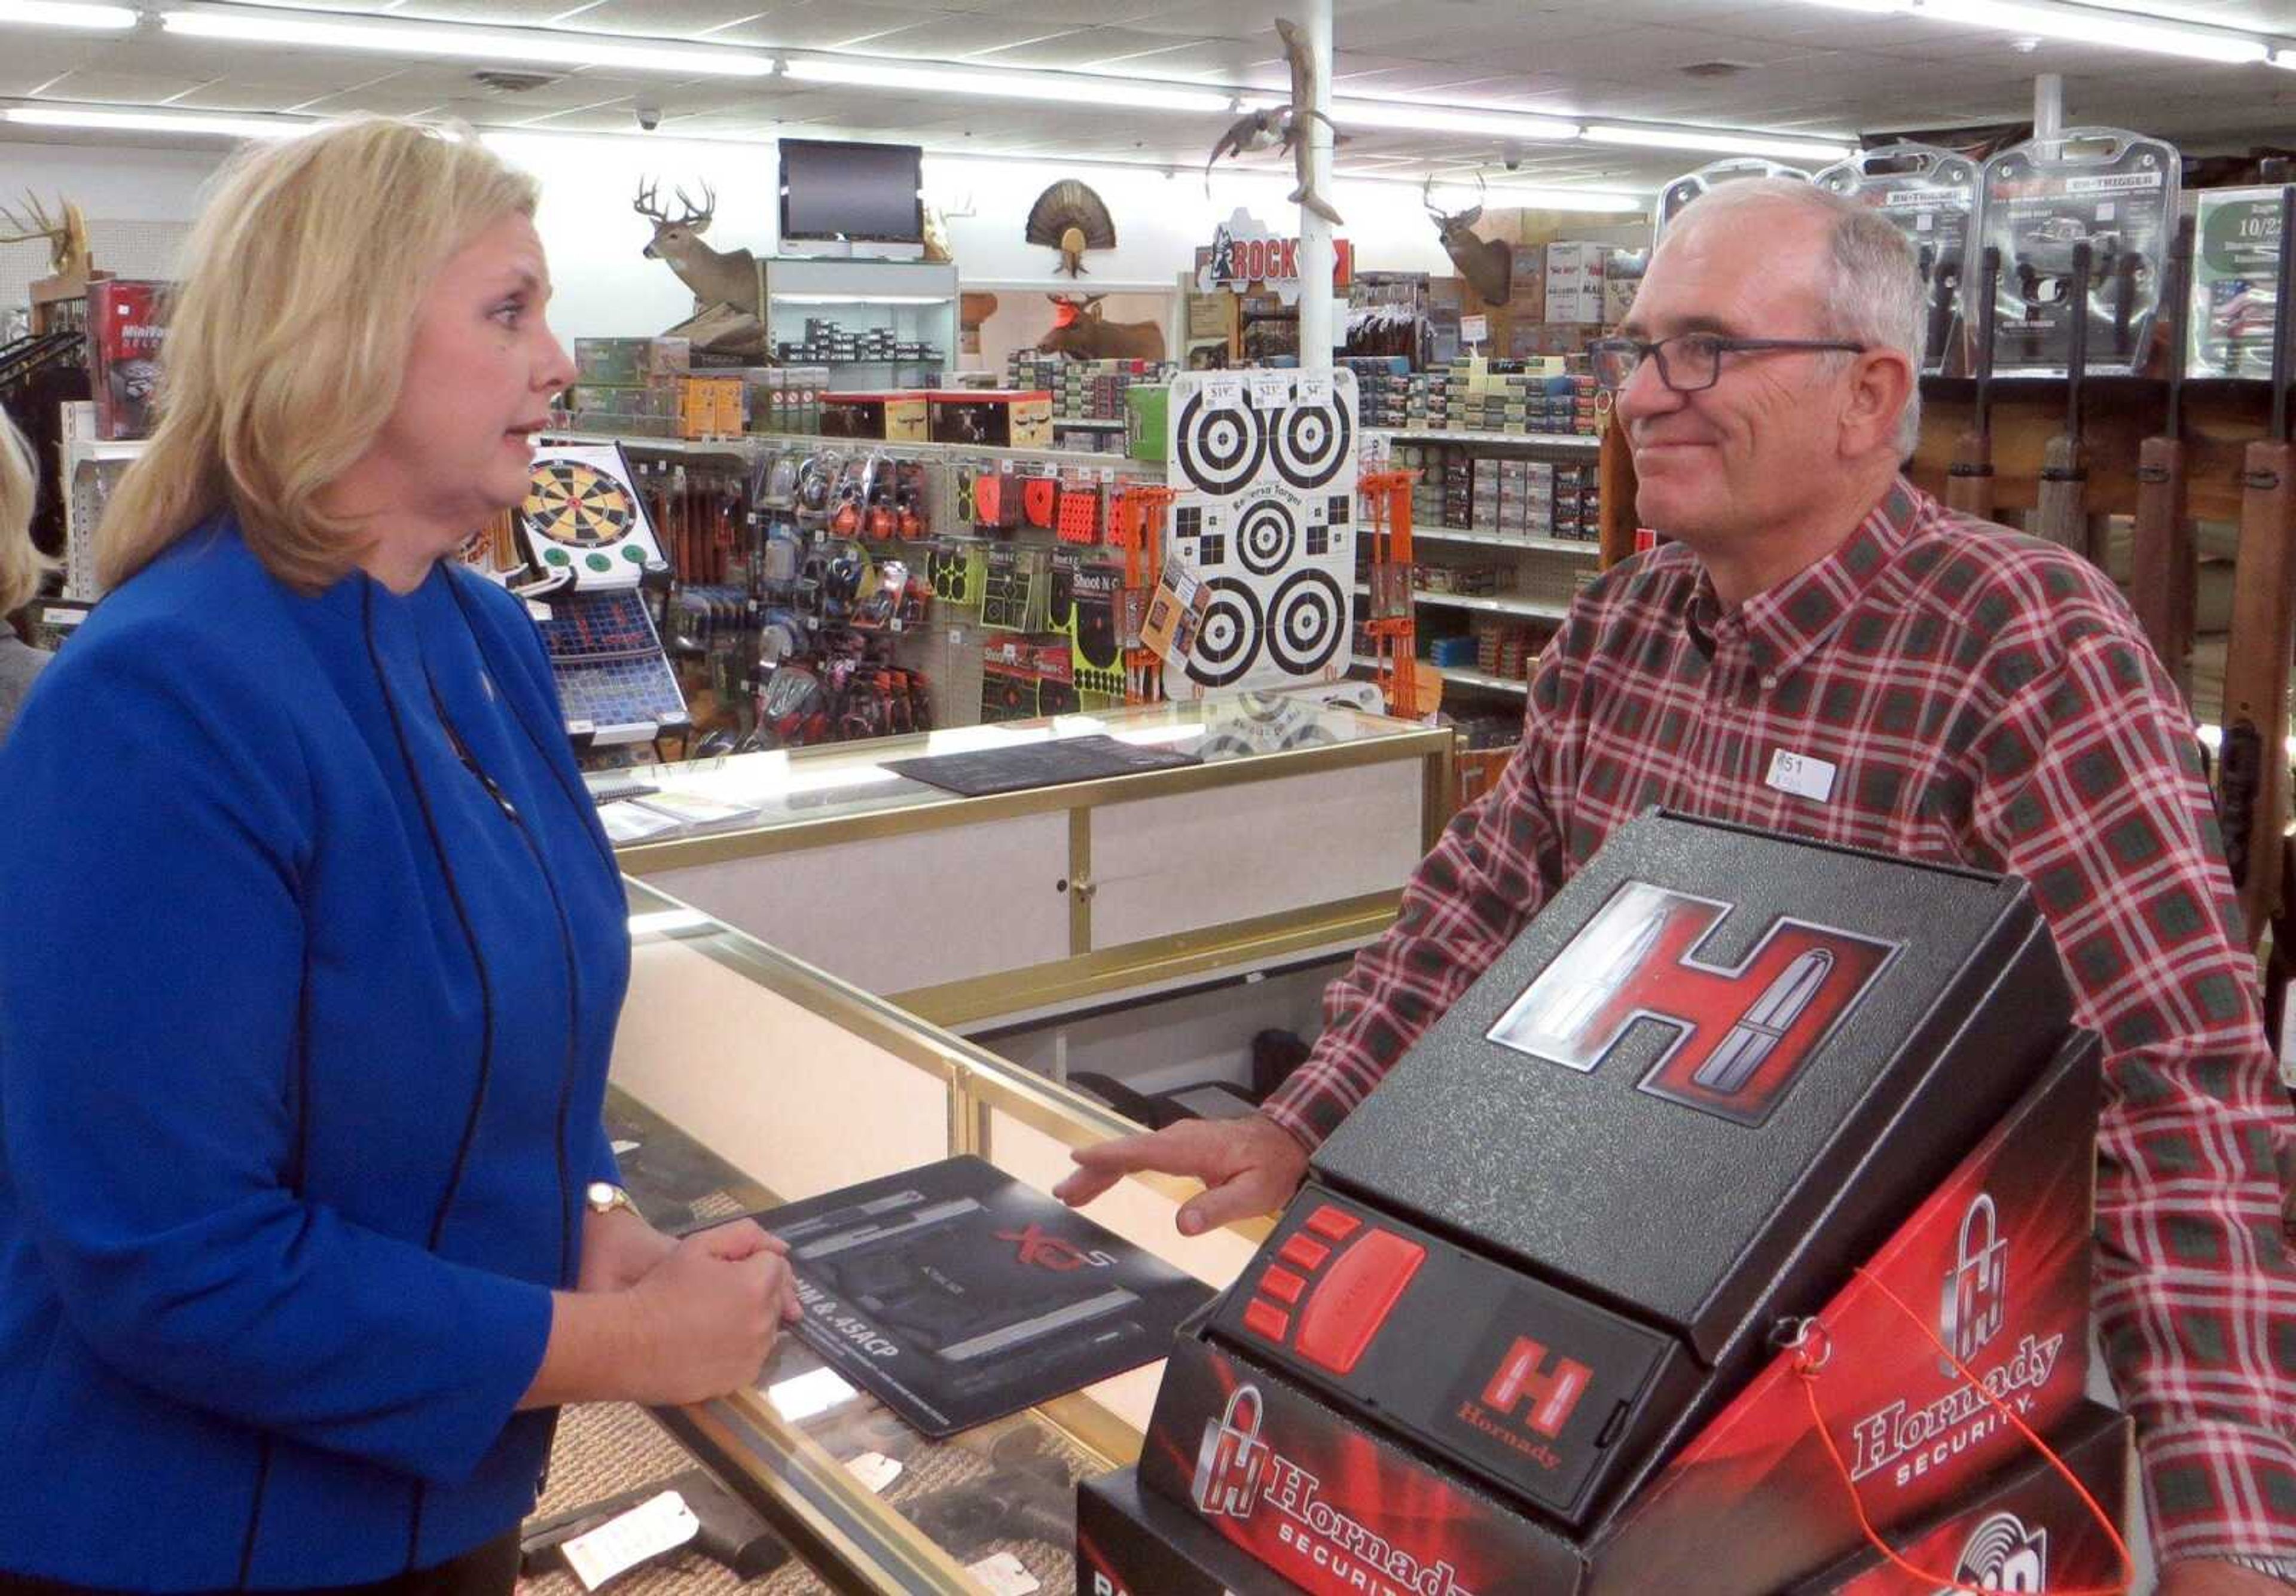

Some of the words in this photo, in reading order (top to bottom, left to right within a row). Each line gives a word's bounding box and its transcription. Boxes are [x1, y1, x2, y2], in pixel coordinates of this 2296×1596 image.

[1233, 238, 1300, 280] ROCK
[826, 1316, 899, 1356] .45ACP
[1457, 1401, 1562, 1470] Hornady
[1851, 1333, 2063, 1482] Hornady
[1264, 1454, 1473, 1596] Hornad
